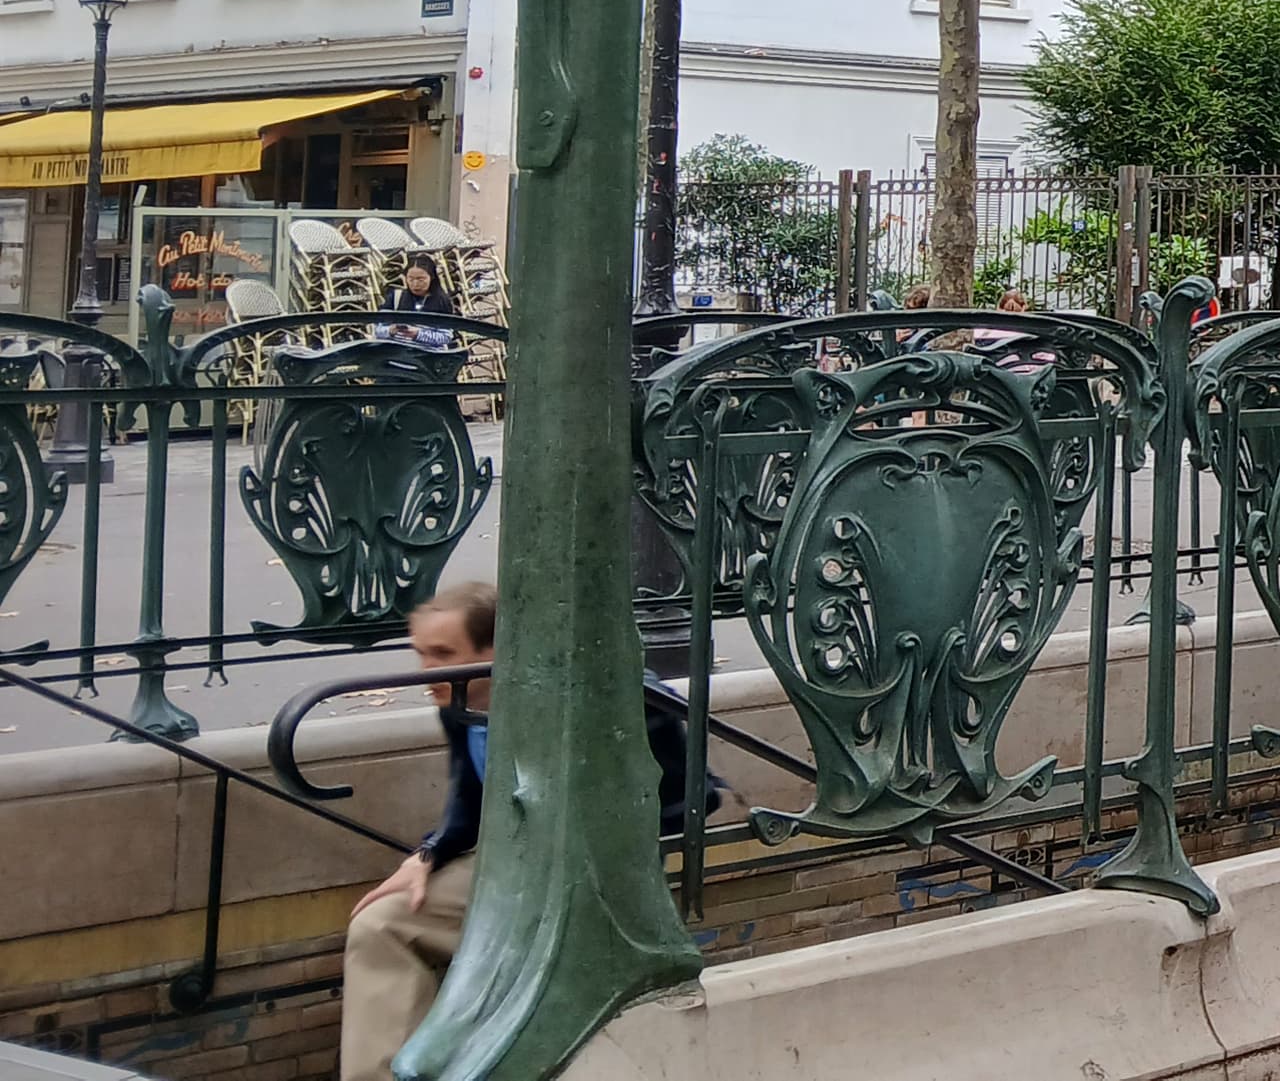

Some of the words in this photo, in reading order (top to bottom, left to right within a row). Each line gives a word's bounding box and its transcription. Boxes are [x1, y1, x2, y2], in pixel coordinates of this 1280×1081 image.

[74, 157, 129, 177] MOARTRE
[158, 244, 180, 267] Au
[172, 272, 206, 290] Hot
[211, 272, 233, 288] do
